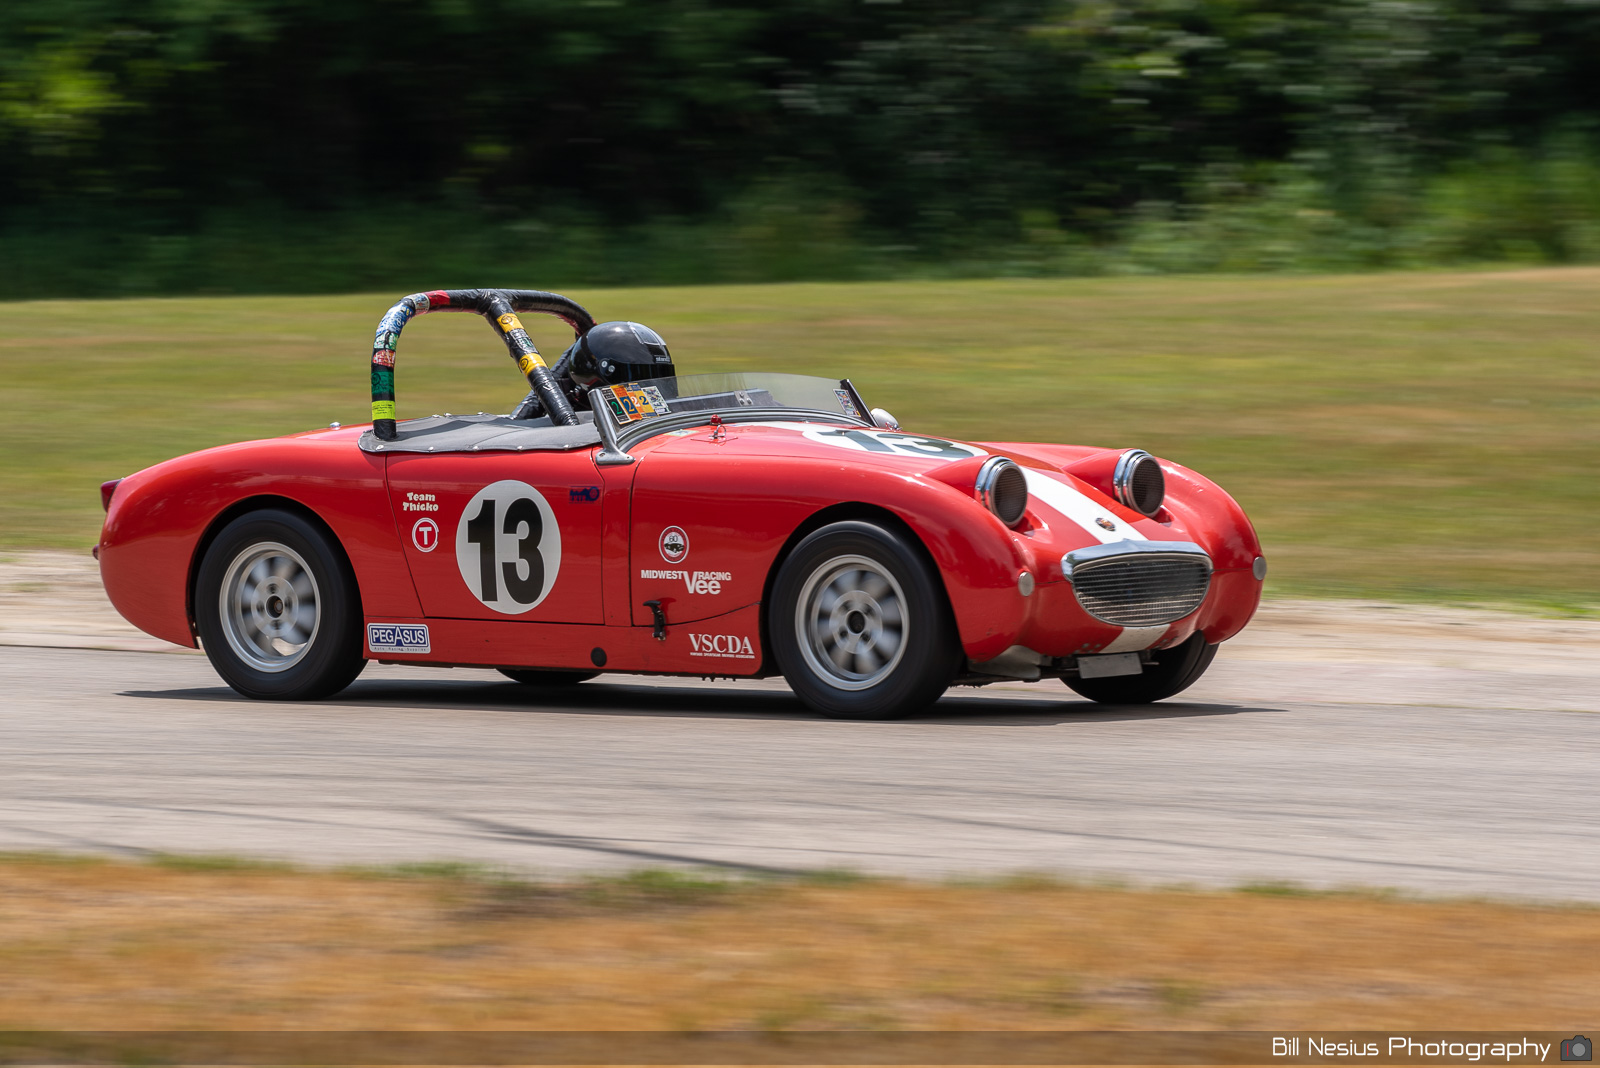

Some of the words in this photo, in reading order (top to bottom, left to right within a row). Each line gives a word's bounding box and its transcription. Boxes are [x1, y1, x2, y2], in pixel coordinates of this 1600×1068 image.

[611, 401, 623, 415] 2
[623, 398, 635, 412] 2
[639, 395, 649, 406] 2
[816, 429, 975, 459] 13
[406, 492, 436, 502] Team
[418, 526, 433, 546] T
[668, 535, 679, 543] 60
[467, 497, 545, 605] 13
[640, 569, 683, 580] MIDWEST
[698, 571, 732, 581] RACING
[682, 570, 722, 595] Vee
[372, 626, 425, 646] PEGASUS
[688, 633, 755, 655] VSCDA
